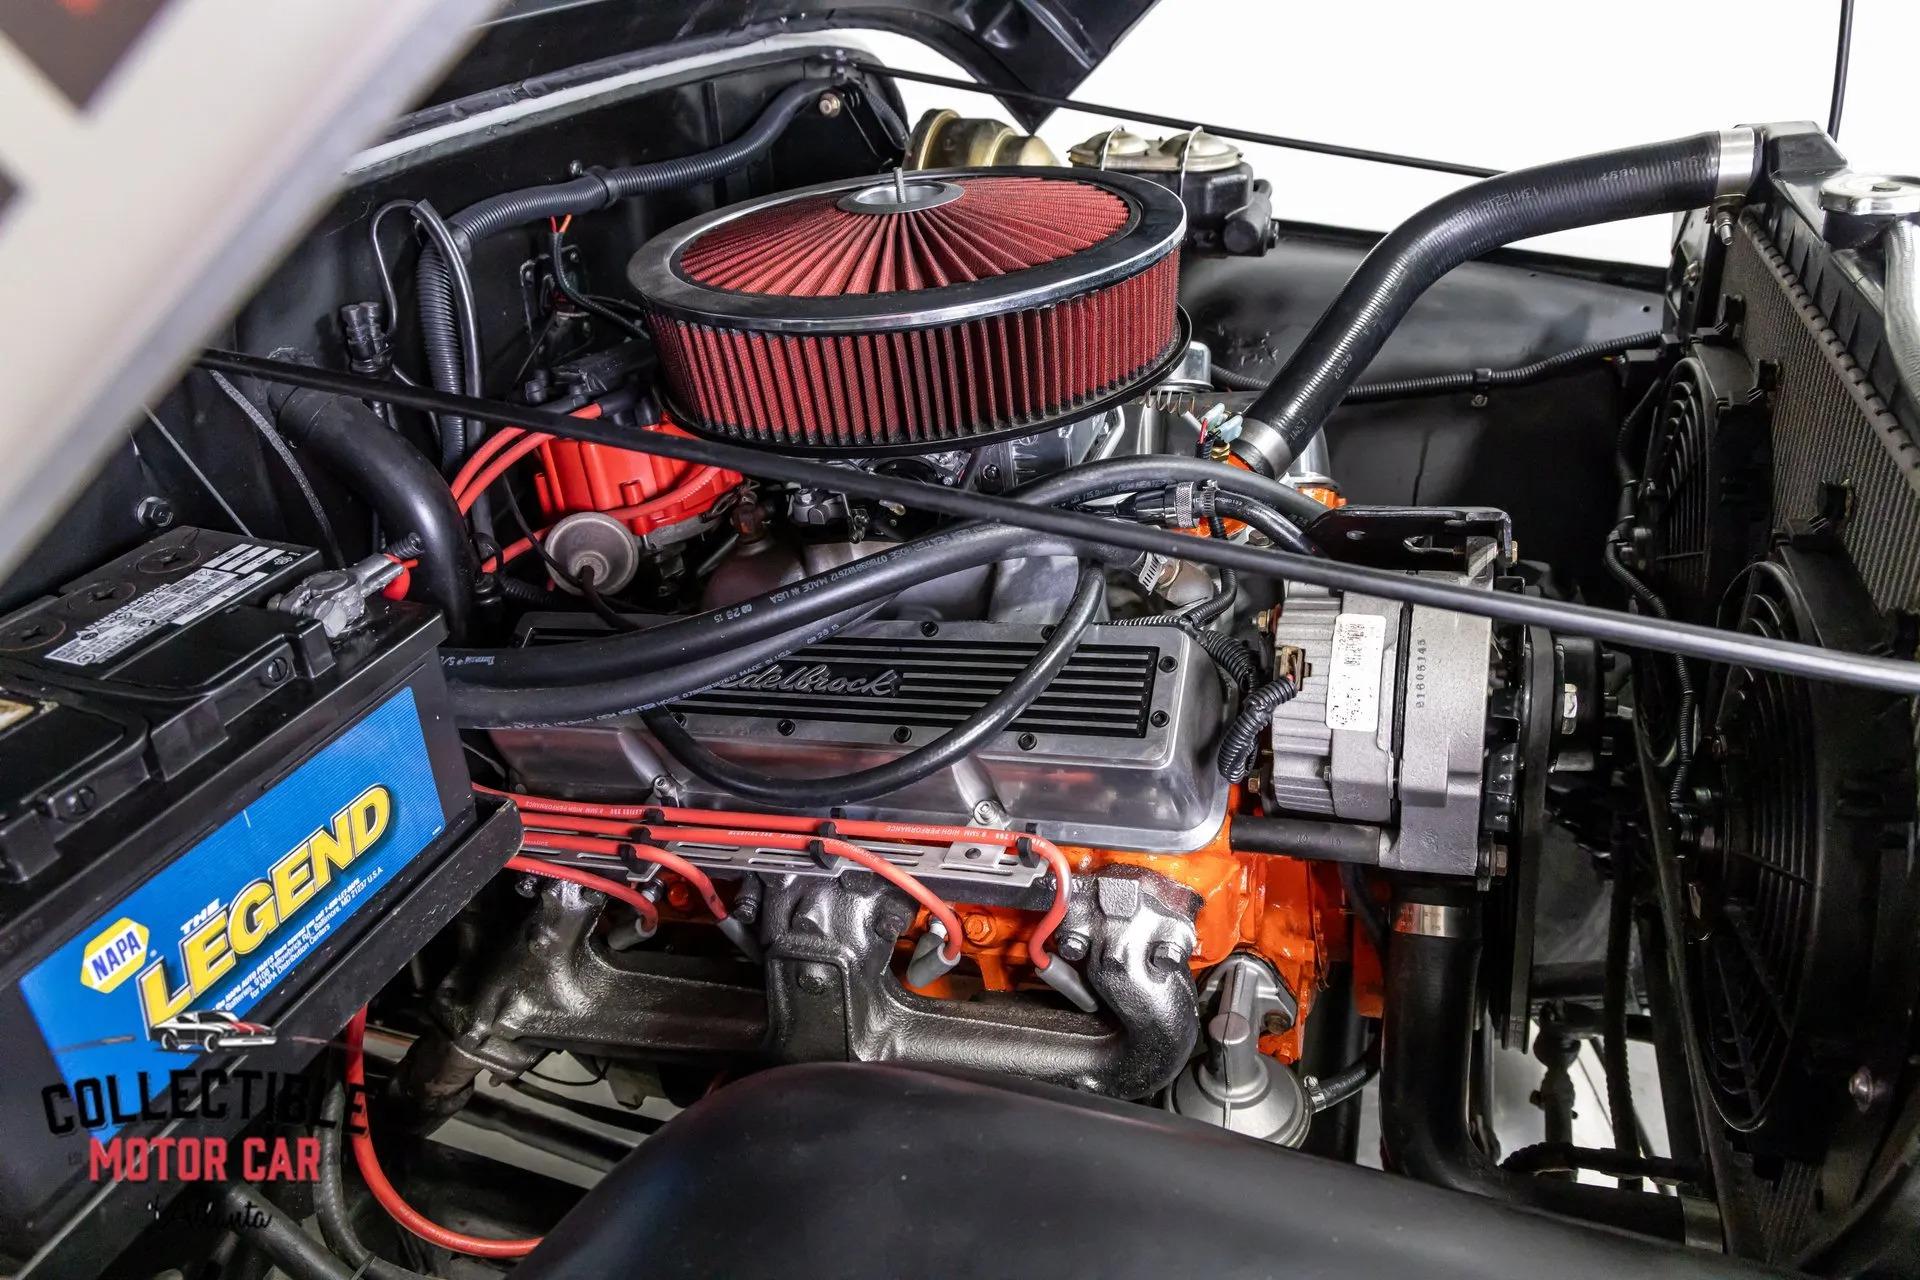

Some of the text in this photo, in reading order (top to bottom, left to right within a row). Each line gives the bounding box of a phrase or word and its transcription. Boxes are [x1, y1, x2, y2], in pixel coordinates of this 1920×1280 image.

[768, 590, 789, 603] USA
[801, 576, 828, 592] MADE
[728, 664, 899, 697] delbrock
[885, 823, 940, 835] PERFORMANCE
[941, 827, 960, 836] HIGH
[339, 894, 351, 907] MD
[349, 880, 367, 898] 21237
[136, 784, 391, 1038] LEGEND
[180, 898, 220, 935] THE
[91, 930, 142, 981] NAPA
[248, 922, 331, 999] for NAPA Distribution Centers
